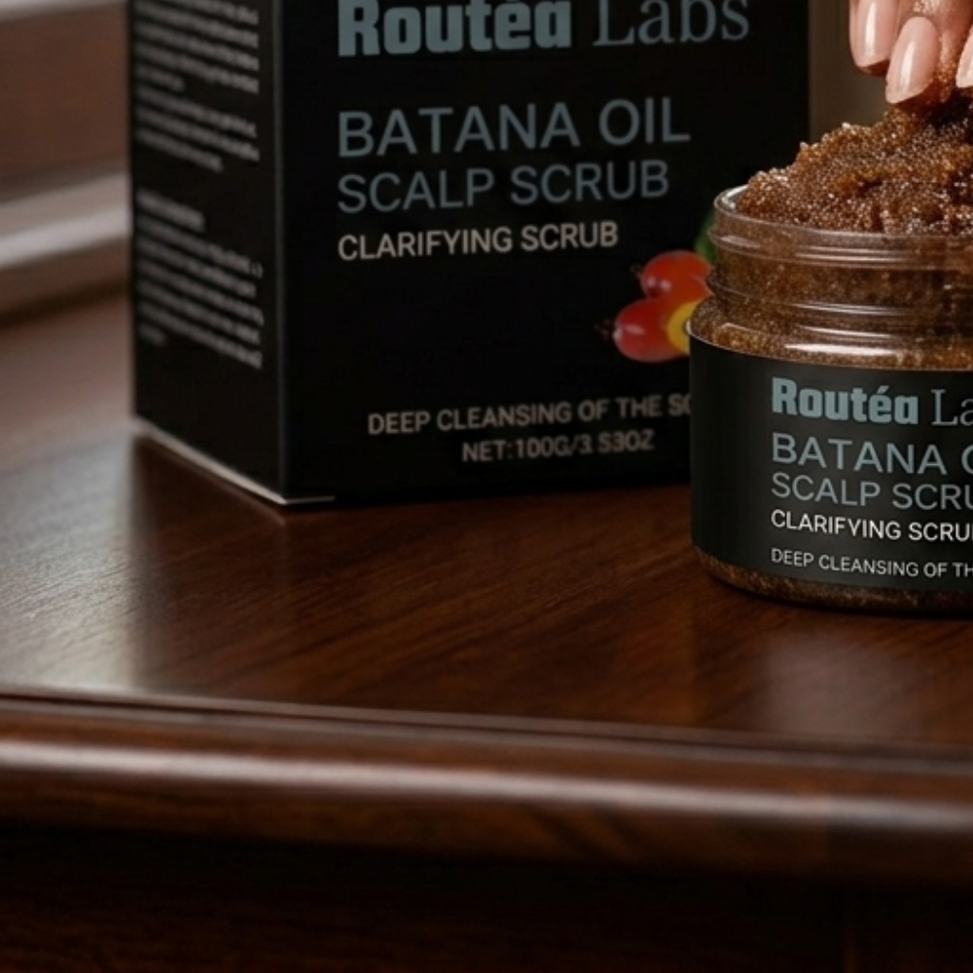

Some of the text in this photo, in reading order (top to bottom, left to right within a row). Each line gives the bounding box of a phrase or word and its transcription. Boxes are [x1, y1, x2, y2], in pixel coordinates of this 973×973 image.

[339, 97, 690, 157] BATANA OIL
[338, 160, 668, 213] SCALP SCRUB
[338, 221, 618, 260] CLARIFYING SCRUB
[368, 411, 430, 434] DEEP
[437, 402, 571, 431] CLEANSING
[578, 399, 608, 421] OF
[616, 395, 661, 417] THE
[772, 378, 918, 424] Routéa
[771, 433, 946, 474] BATANA
[771, 472, 881, 506] SCALP
[772, 509, 901, 539] CLARIFYING
[772, 548, 814, 566] DEEP
[819, 555, 918, 576] CLEANSING
[924, 562, 947, 577] OF
